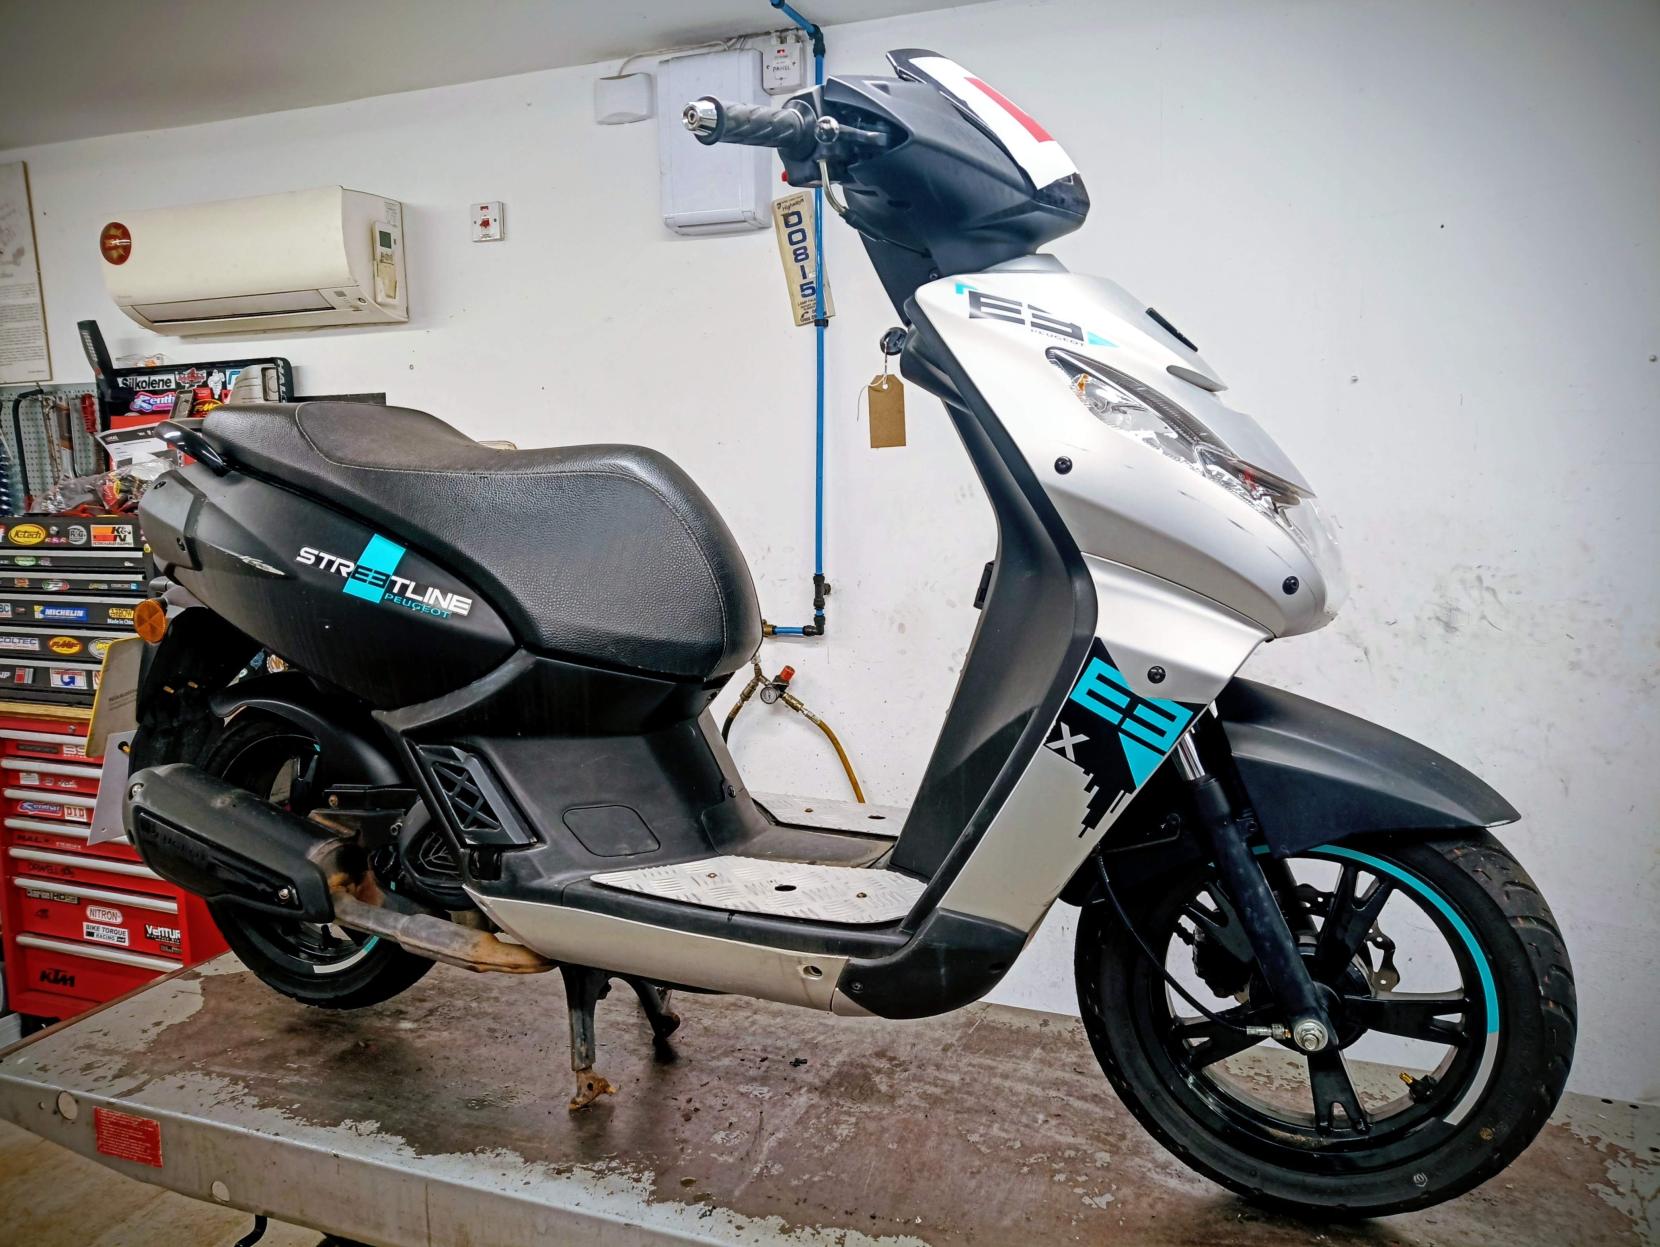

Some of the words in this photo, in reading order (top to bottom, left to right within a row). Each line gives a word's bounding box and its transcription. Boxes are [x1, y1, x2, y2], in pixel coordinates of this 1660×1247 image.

[122, 377, 172, 390] Silkolene
[384, 592, 451, 619] PEUGEOT
[45, 608, 84, 617] MICHELIN
[66, 806, 85, 817] DID
[89, 907, 118, 921] NITRON
[85, 924, 100, 932] BIKE
[101, 926, 127, 937] TORQUE
[40, 968, 75, 988] KTM
